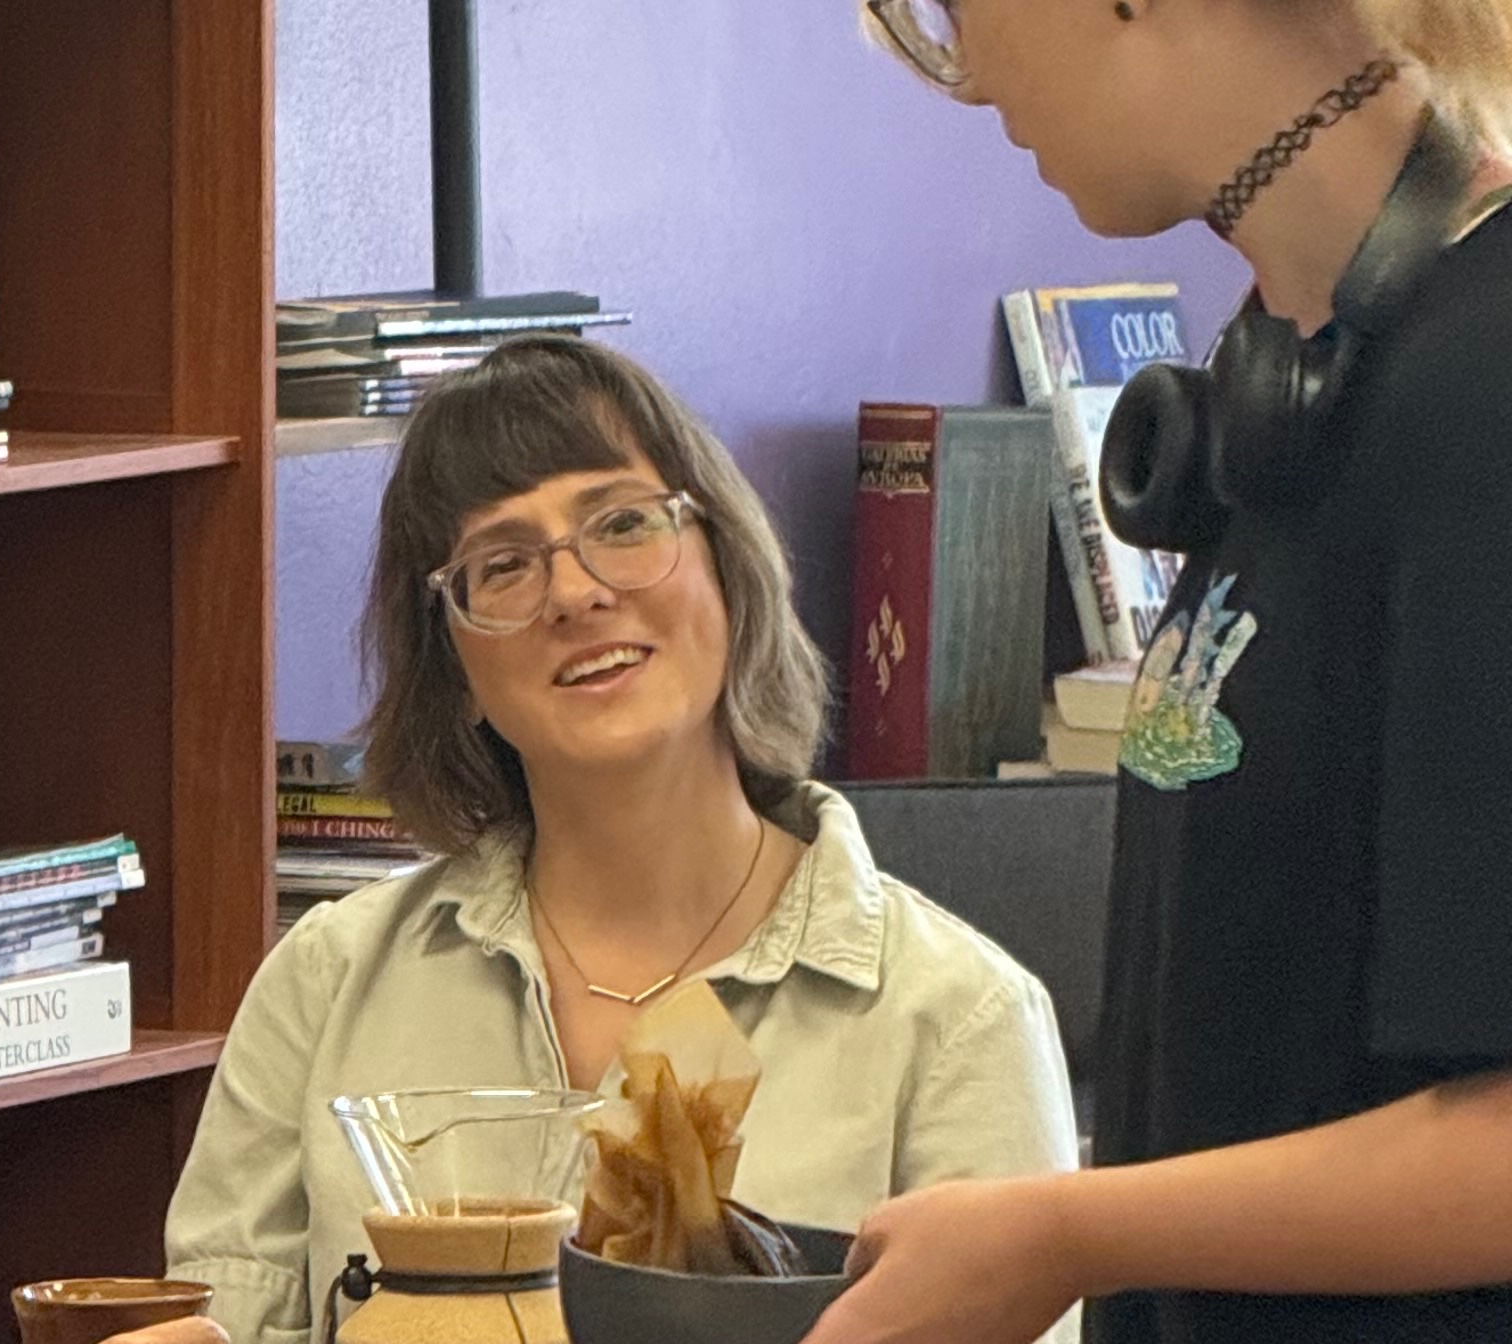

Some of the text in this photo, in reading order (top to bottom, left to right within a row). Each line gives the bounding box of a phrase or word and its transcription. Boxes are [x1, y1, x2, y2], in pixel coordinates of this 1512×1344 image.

[1111, 311, 1184, 359] COLOR
[1081, 532, 1120, 625] DISPLACED
[277, 793, 317, 814] EGAL
[325, 820, 395, 838] CHING
